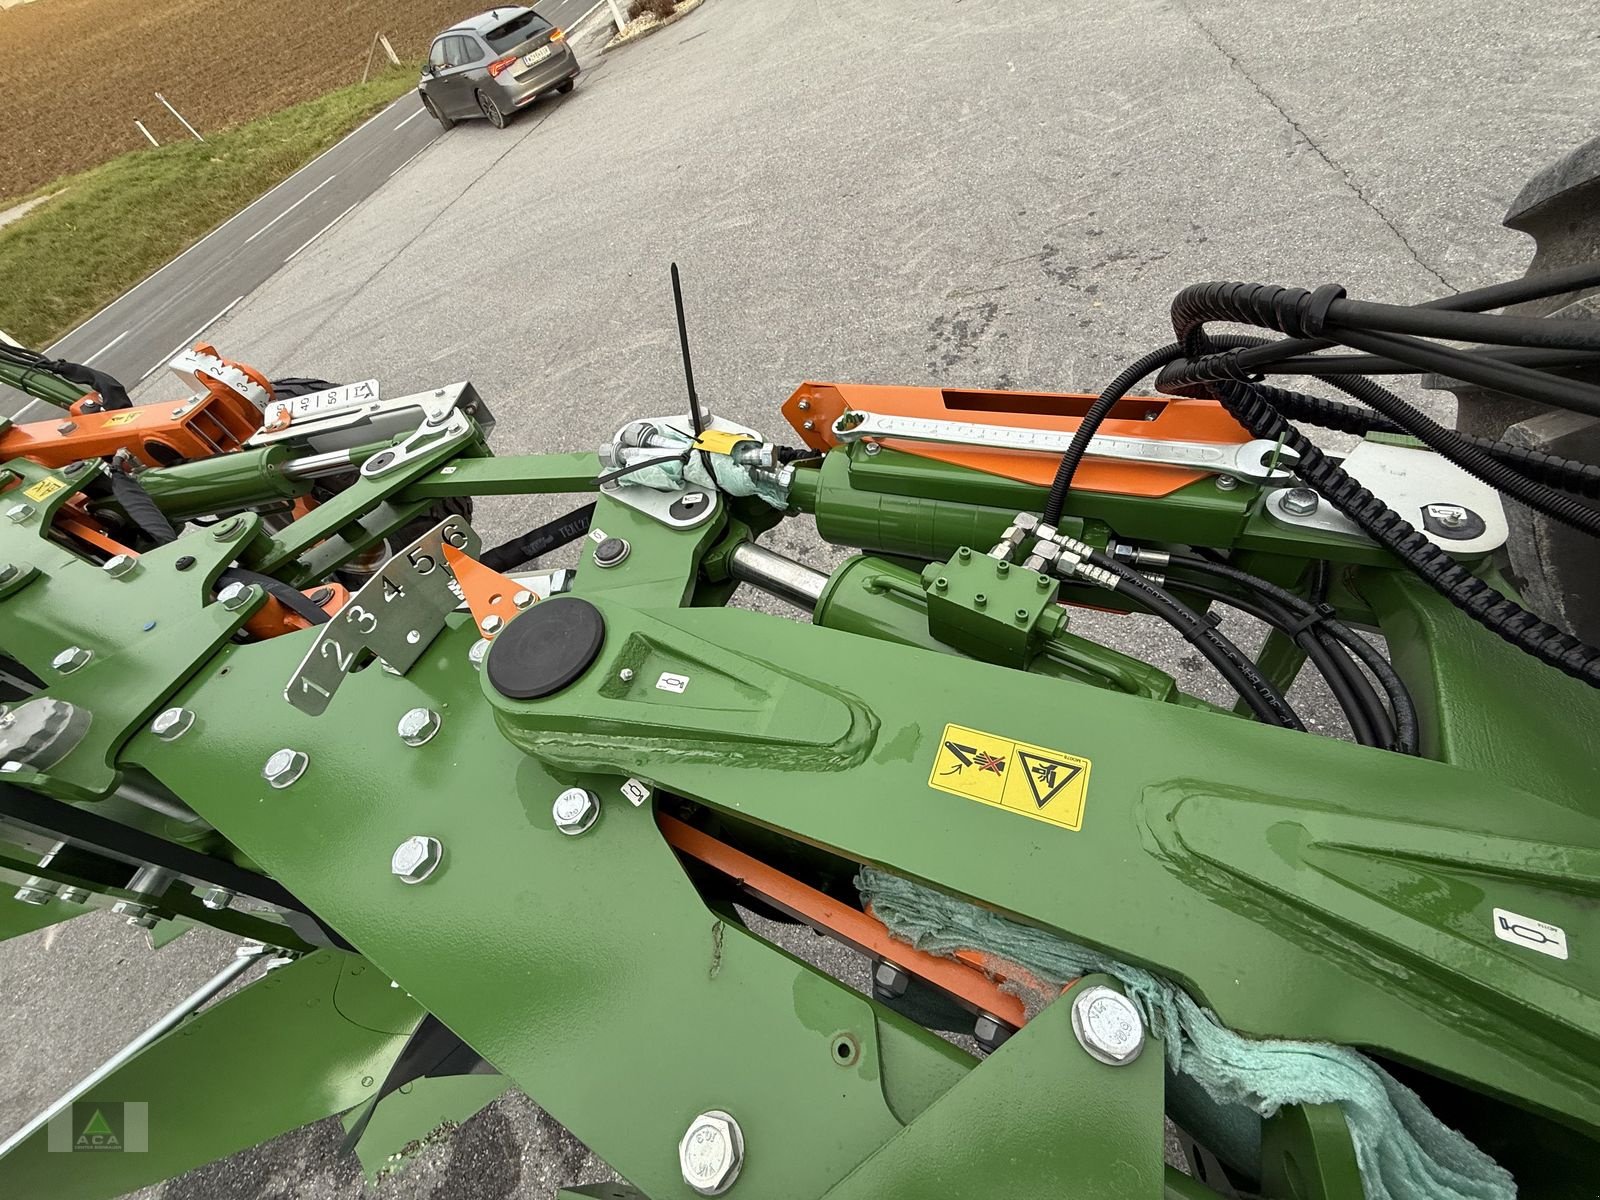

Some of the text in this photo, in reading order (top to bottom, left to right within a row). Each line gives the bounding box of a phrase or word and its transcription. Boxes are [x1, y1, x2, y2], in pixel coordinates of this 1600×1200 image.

[210, 366, 224, 377] 2
[236, 381, 249, 393] 3
[300, 397, 310, 411] 40
[328, 391, 338, 405] 50
[301, 523, 469, 699] 1 2 3 4 5 6
